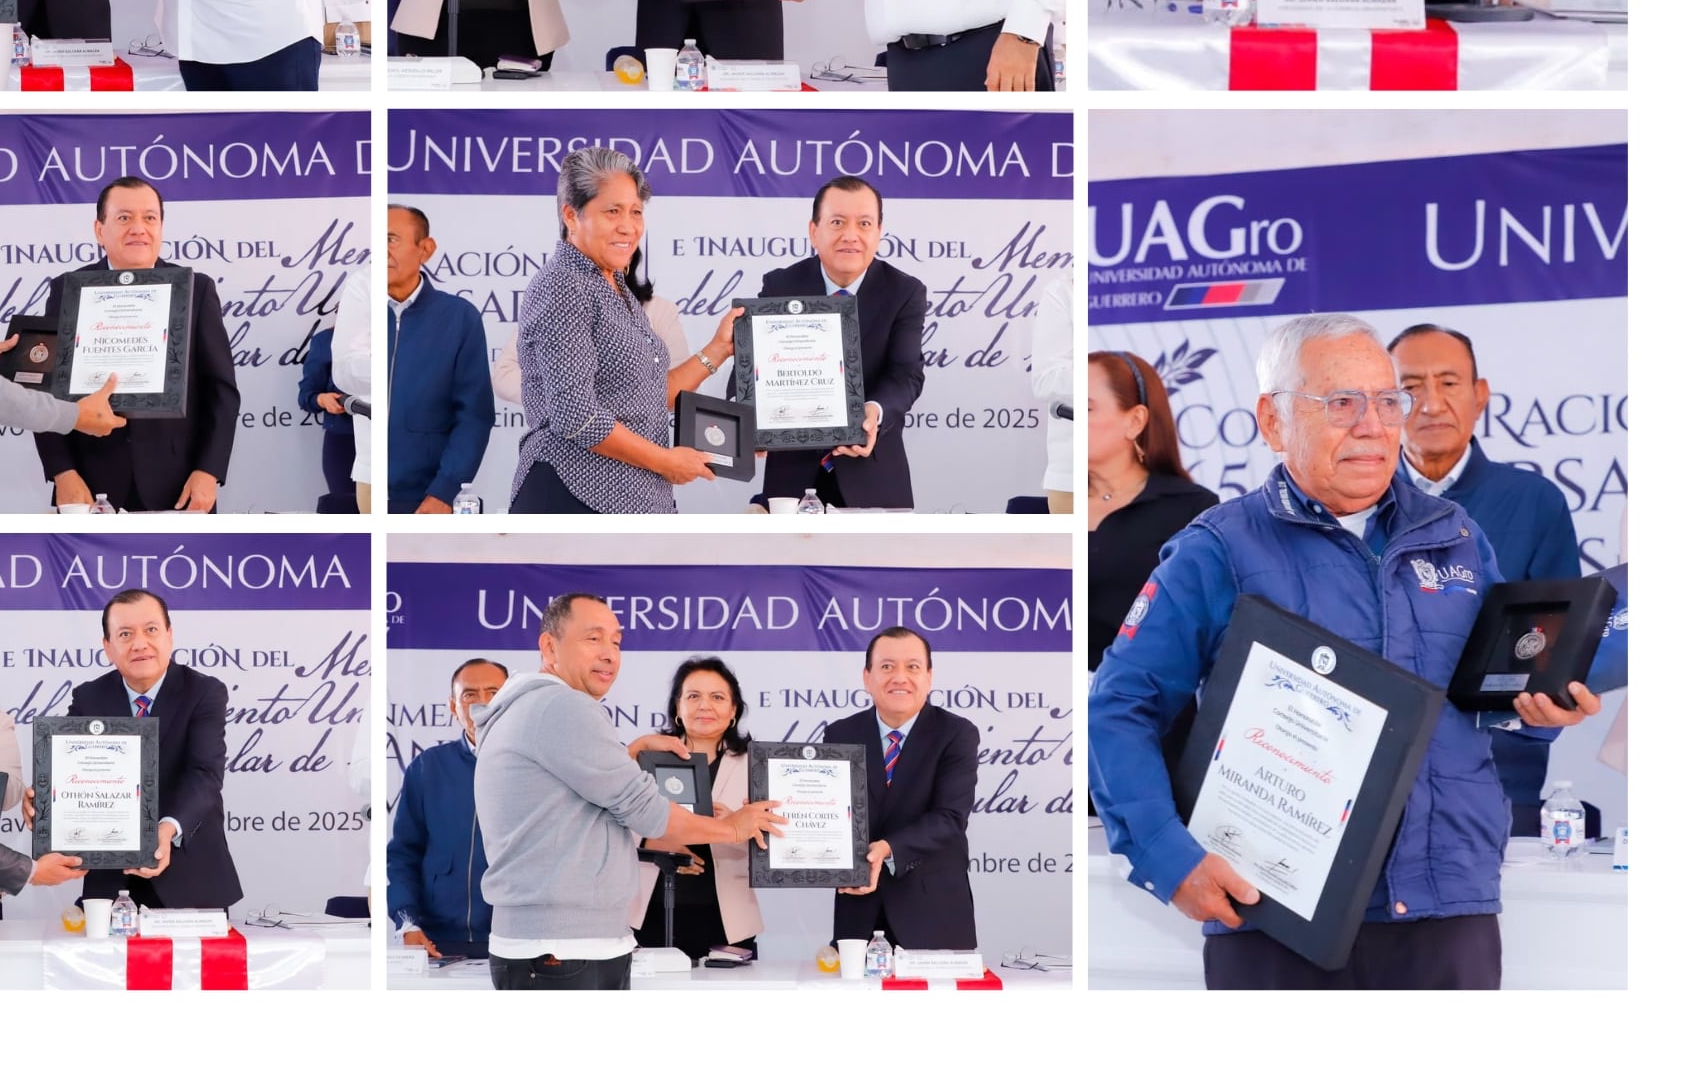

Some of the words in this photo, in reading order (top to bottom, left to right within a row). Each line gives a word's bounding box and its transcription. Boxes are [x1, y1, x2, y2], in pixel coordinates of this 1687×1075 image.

[38, 134, 336, 183] AUTÓNOMA
[733, 129, 1031, 178] AUTÓNOMA
[1088, 194, 1303, 268] UAGro
[237, 240, 281, 259] DEL
[672, 239, 685, 256] E
[929, 241, 971, 259] DEL
[675, 269, 744, 316] del
[123, 345, 158, 353] GARCÍA
[964, 322, 1009, 369] de
[766, 378, 809, 387] MARTÍNEZ
[777, 369, 822, 377] BERTOLDO
[955, 407, 975, 429] de
[979, 407, 1040, 429] 2025
[62, 544, 352, 590] AUTÓNOMA
[817, 587, 1072, 631] AUTÓNOM
[2, 650, 15, 668] E
[253, 650, 294, 668] DEL
[759, 691, 770, 708] E
[1007, 692, 1049, 709] DEL
[289, 727, 332, 773] de
[1244, 727, 1335, 785] Reconocimiento
[66, 774, 127, 784] Reconocimiento
[1255, 765, 1306, 802] ARTURO
[61, 791, 94, 799] OTHÓN
[95, 791, 131, 799] SALAZAR
[78, 800, 115, 809] RAMÍREZ
[1218, 765, 1276, 805] MIRANDA
[1278, 796, 1334, 836] RAMÍREZ
[271, 810, 301, 832] de
[308, 810, 364, 832] 2025
[1027, 852, 1056, 873] de
